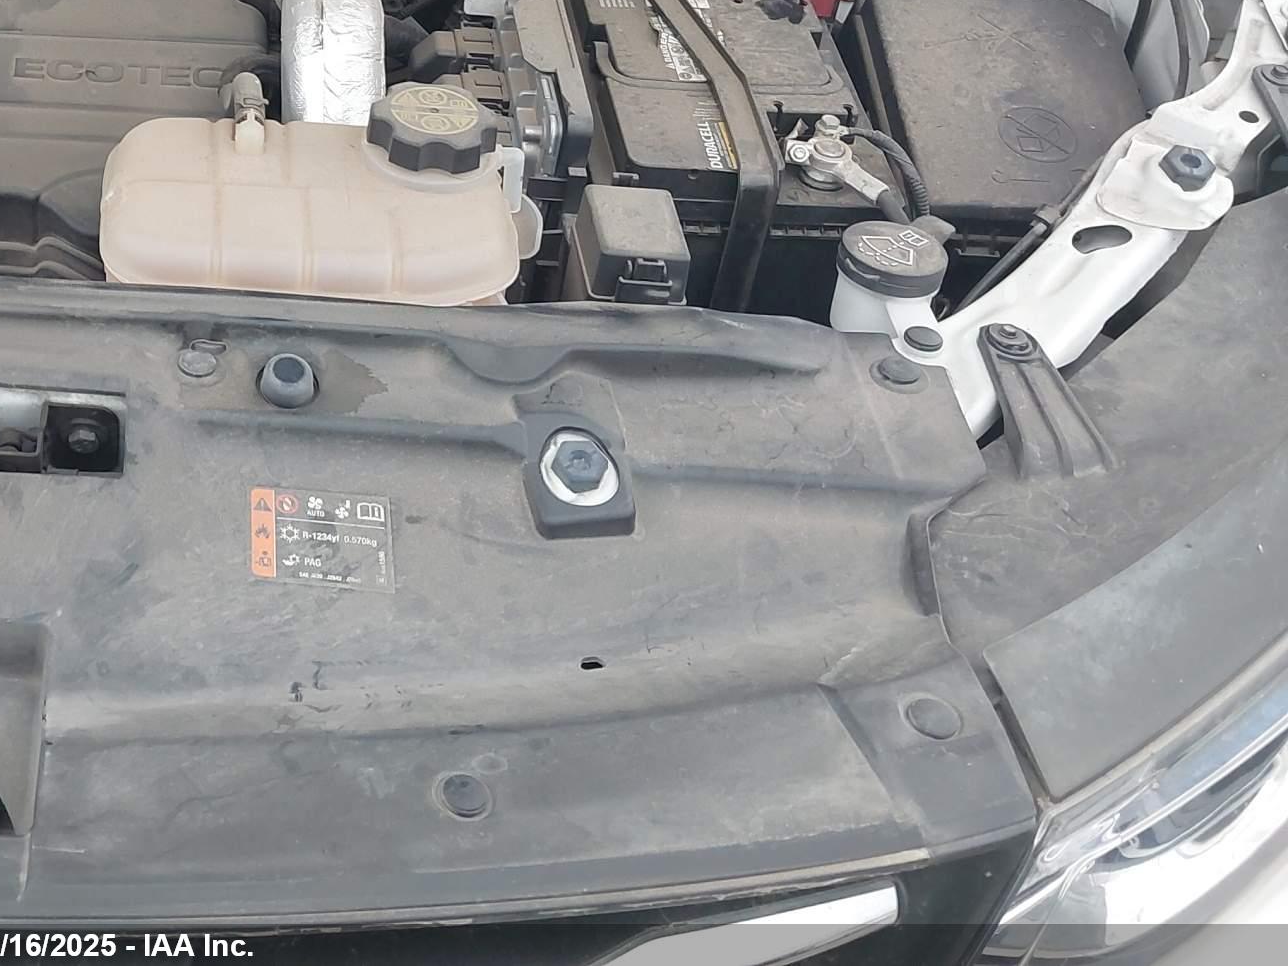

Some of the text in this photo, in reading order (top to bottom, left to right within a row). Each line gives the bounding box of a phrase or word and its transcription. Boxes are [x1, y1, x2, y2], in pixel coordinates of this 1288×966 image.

[13, 57, 226, 88] ECOTEC
[697, 120, 723, 168] DURACELL
[307, 510, 325, 518] AUTO
[344, 535, 377, 547] 0.570kg
[304, 558, 322, 567] PAG
